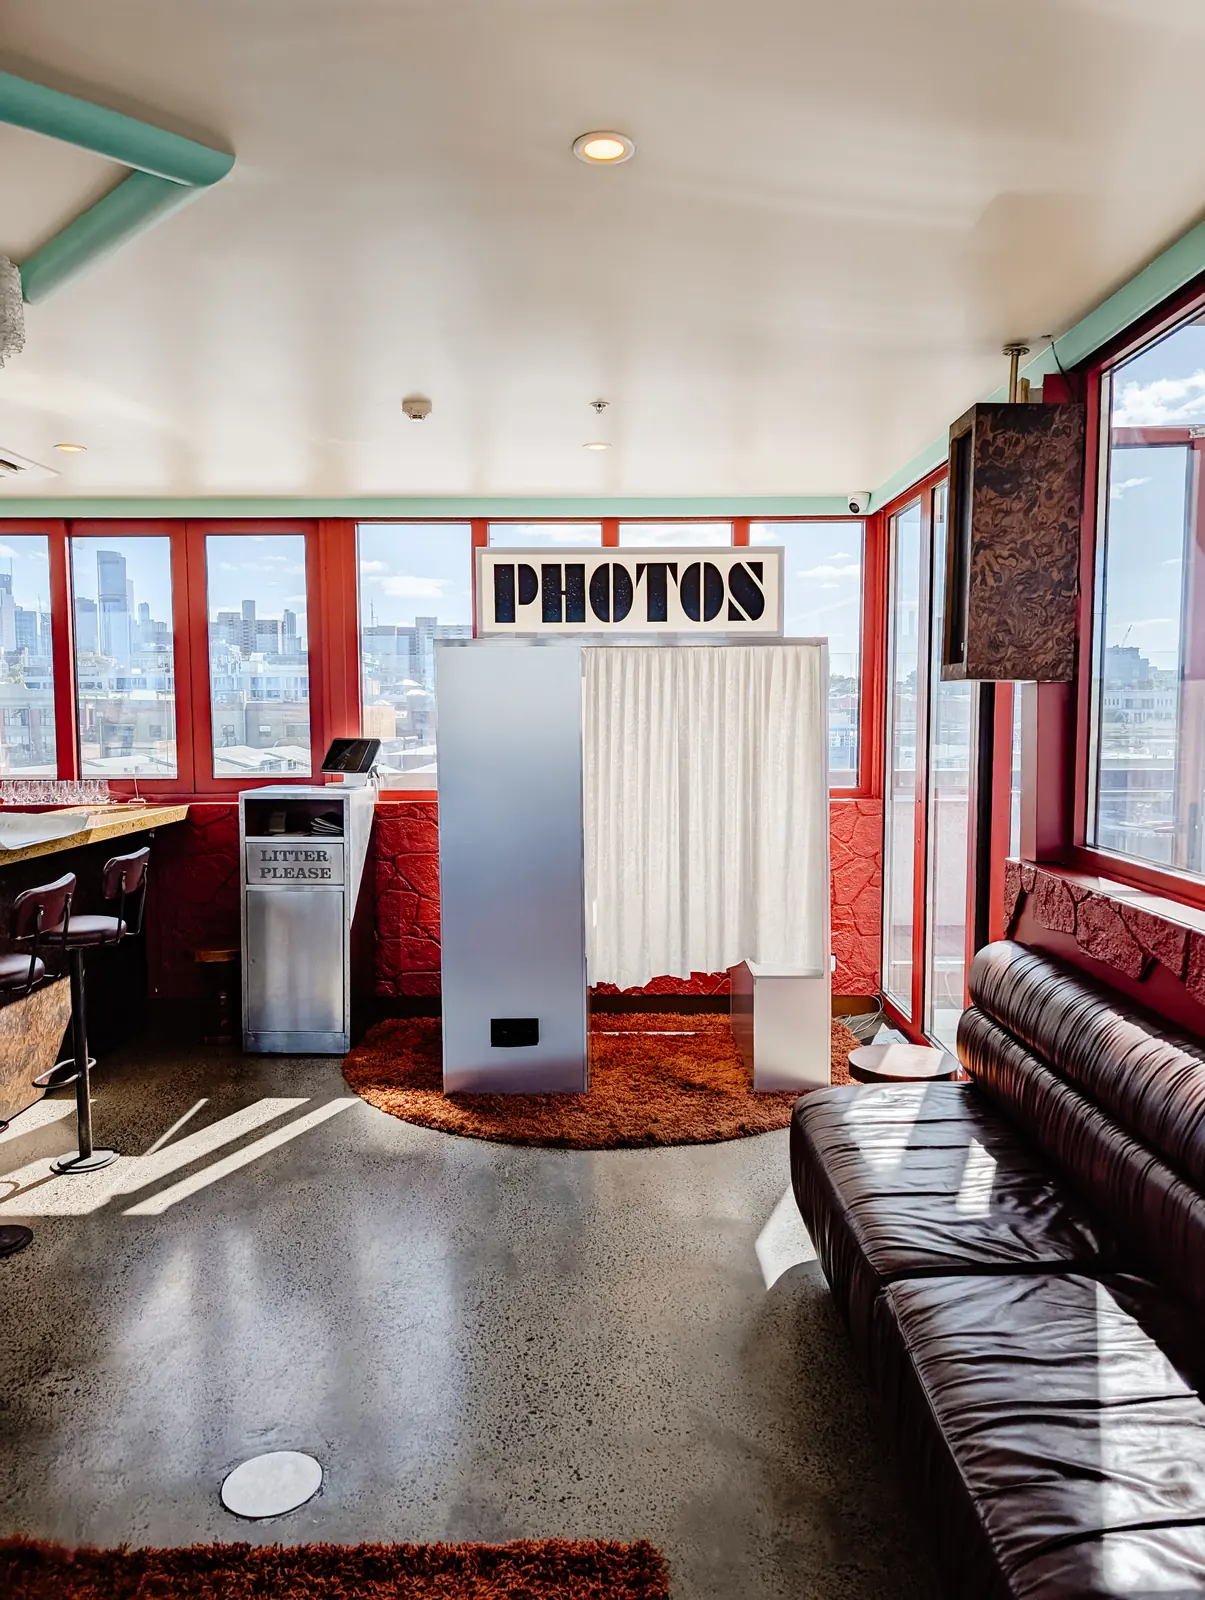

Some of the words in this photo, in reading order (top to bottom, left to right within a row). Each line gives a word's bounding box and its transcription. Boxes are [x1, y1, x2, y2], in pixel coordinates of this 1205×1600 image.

[494, 562, 765, 623] PHOTOS
[260, 850, 329, 862] LITTER
[259, 867, 332, 879] PLEASE
